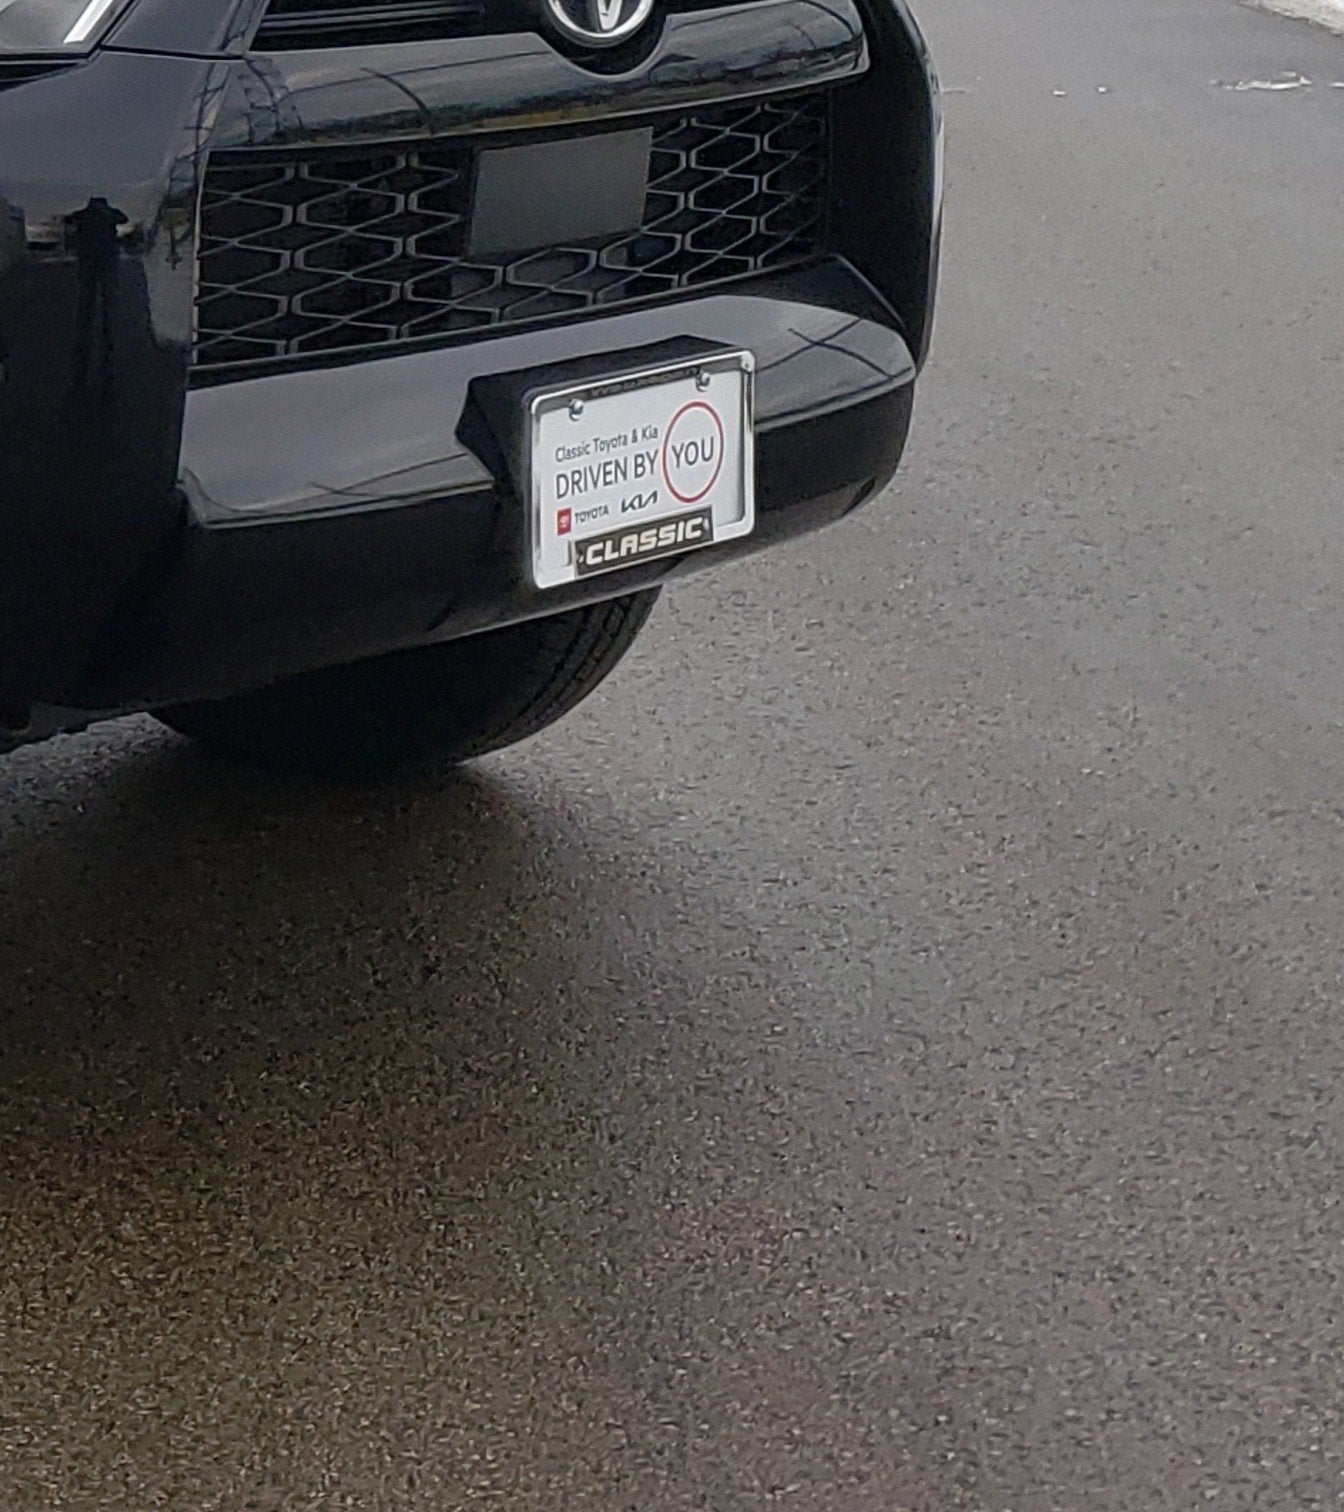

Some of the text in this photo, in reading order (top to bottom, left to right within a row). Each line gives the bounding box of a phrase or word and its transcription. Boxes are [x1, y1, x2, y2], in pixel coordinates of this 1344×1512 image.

[555, 424, 659, 462] Classic Toyota & Kia
[555, 436, 714, 500] DRIVEN BY YOU
[574, 505, 609, 524] TOYOTA
[586, 517, 704, 565] CLASSIC
